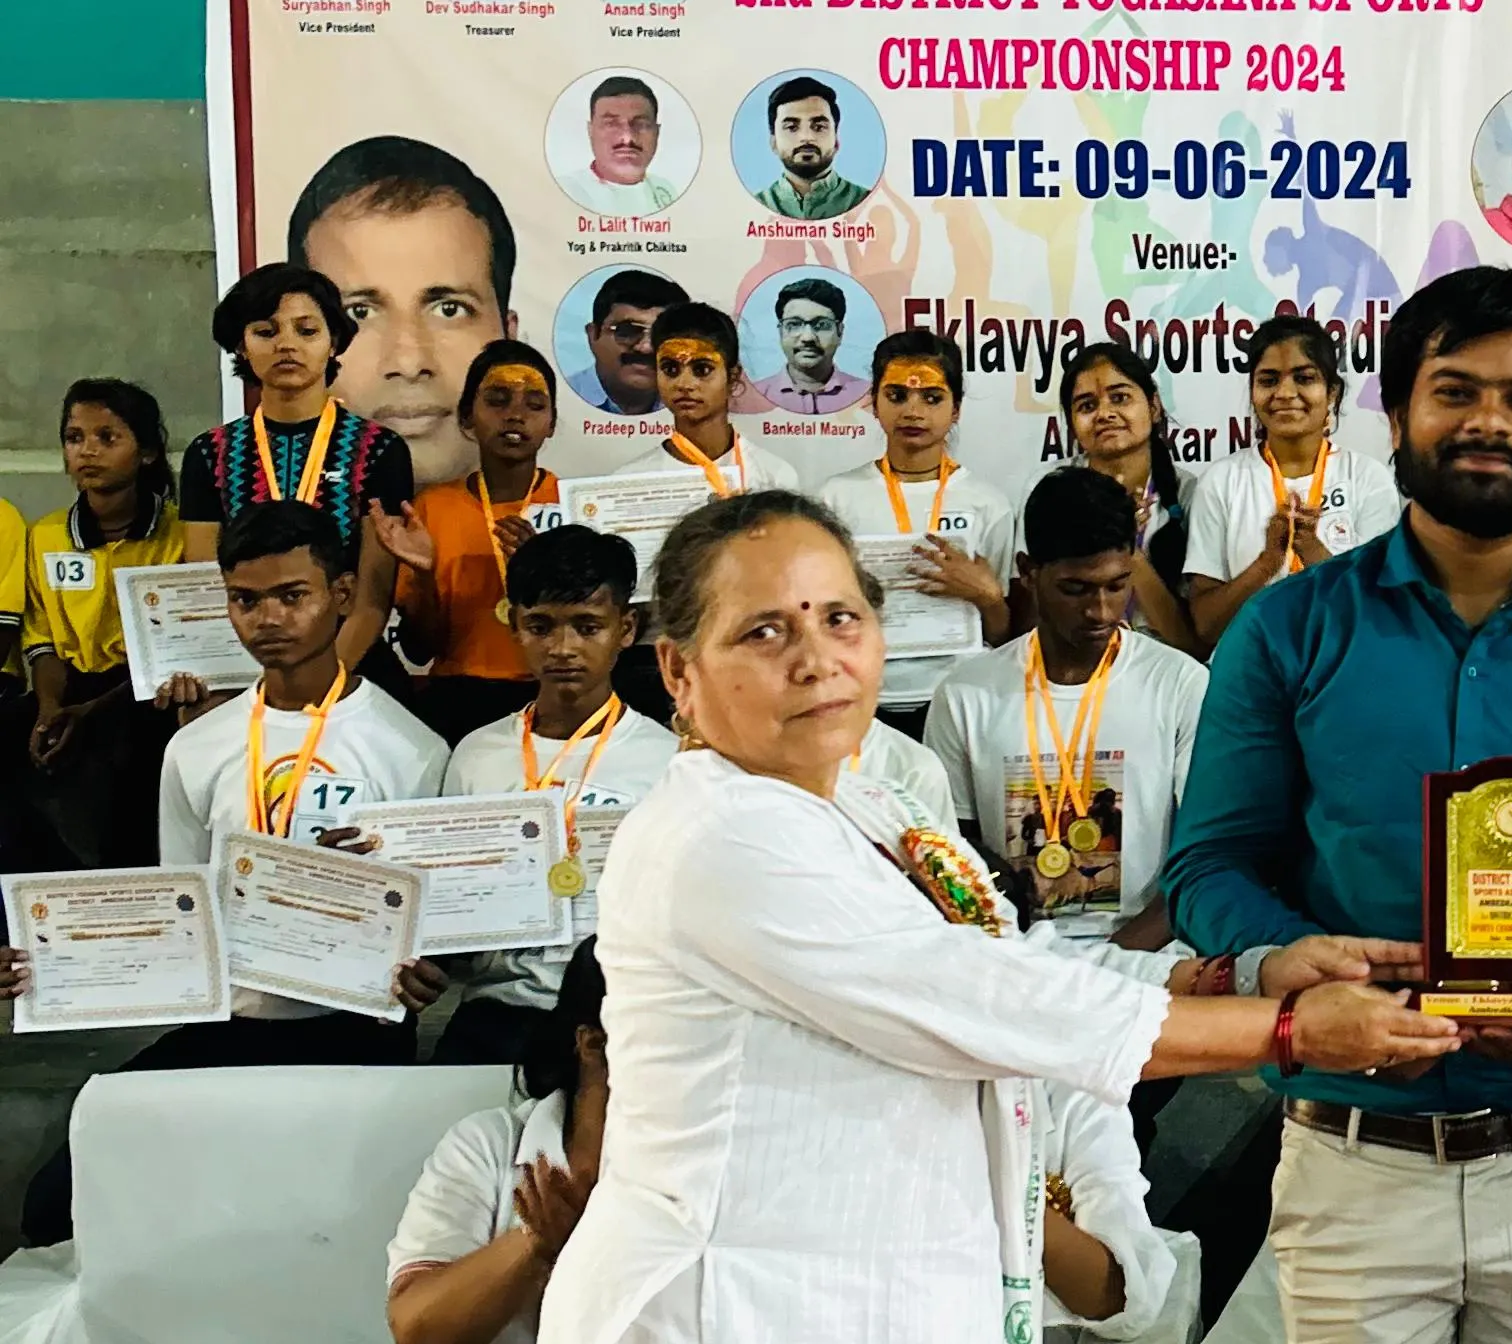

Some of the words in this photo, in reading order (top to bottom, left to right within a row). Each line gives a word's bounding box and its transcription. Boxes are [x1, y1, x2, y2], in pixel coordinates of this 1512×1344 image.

[355, 0, 391, 14] Singh
[425, 0, 449, 15] Dev
[453, 1, 516, 15] Sudhakar
[519, 2, 555, 17] Singh
[604, 2, 645, 17] Anand
[649, 3, 686, 19] Singh
[298, 22, 323, 33] Vice
[326, 23, 375, 34] President
[465, 25, 515, 37] Treasurer
[610, 26, 633, 38] Vice
[879, 37, 1231, 92] CHAMPIONSHIP
[1246, 44, 1346, 92] 2024
[911, 139, 1060, 198] DATE:
[1075, 139, 1412, 200] 09-06-2024
[578, 217, 595, 233] Dr.
[599, 217, 628, 233] Lalit
[631, 217, 671, 233] Tiwari
[746, 221, 827, 238] Anshuman
[832, 222, 875, 242] Singh
[567, 241, 585, 255] Yog
[589, 242, 596, 253] &
[646, 241, 687, 254] Chikitsa
[1132, 233, 1238, 271] Venue:-
[583, 420, 634, 438] Pradeep
[763, 421, 817, 436] Bankelal
[820, 422, 866, 438] Maurya
[56, 560, 85, 582] 03
[313, 783, 355, 810] 17
